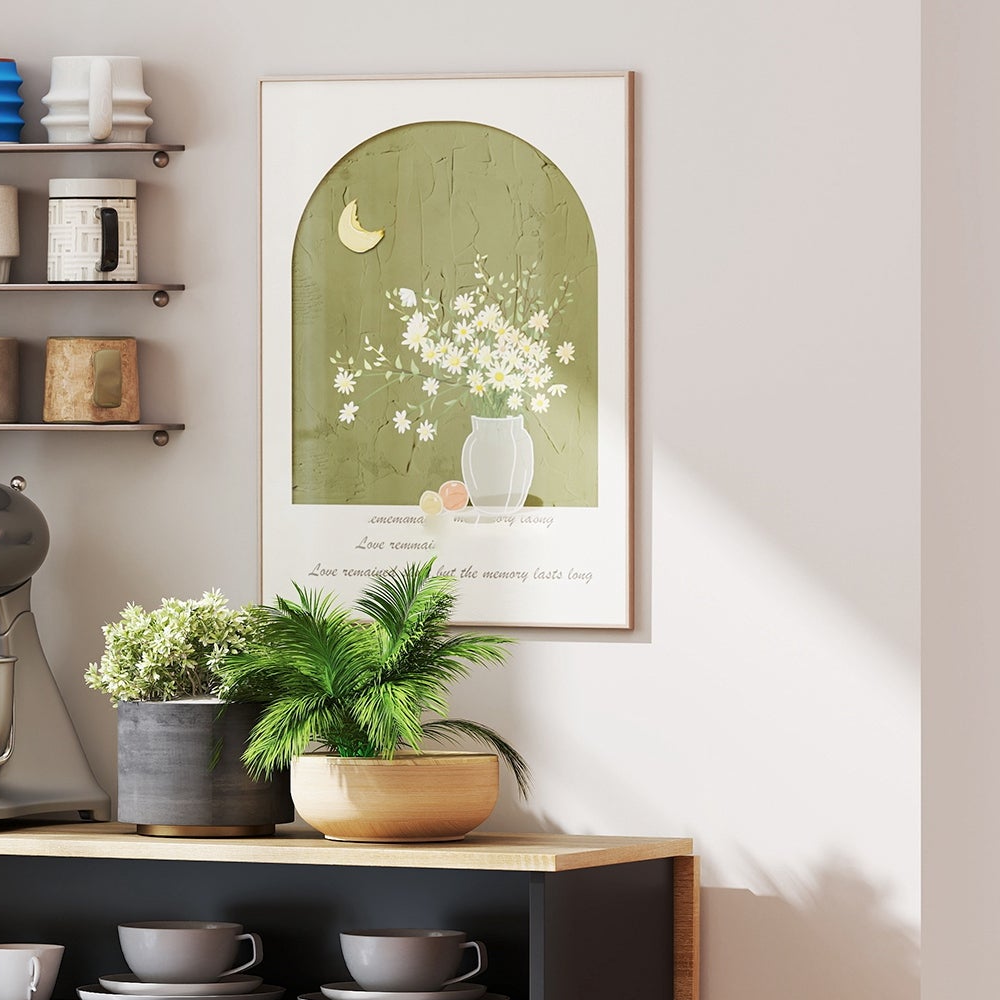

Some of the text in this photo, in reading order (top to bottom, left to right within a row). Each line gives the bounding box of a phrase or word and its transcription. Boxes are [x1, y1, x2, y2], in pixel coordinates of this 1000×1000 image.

[355, 535, 385, 550] Love
[308, 562, 338, 577] Love
[436, 565, 457, 577] but
[460, 565, 478, 579] the
[482, 569, 529, 583] memory
[533, 567, 563, 580] lasts
[567, 567, 593, 584] long
